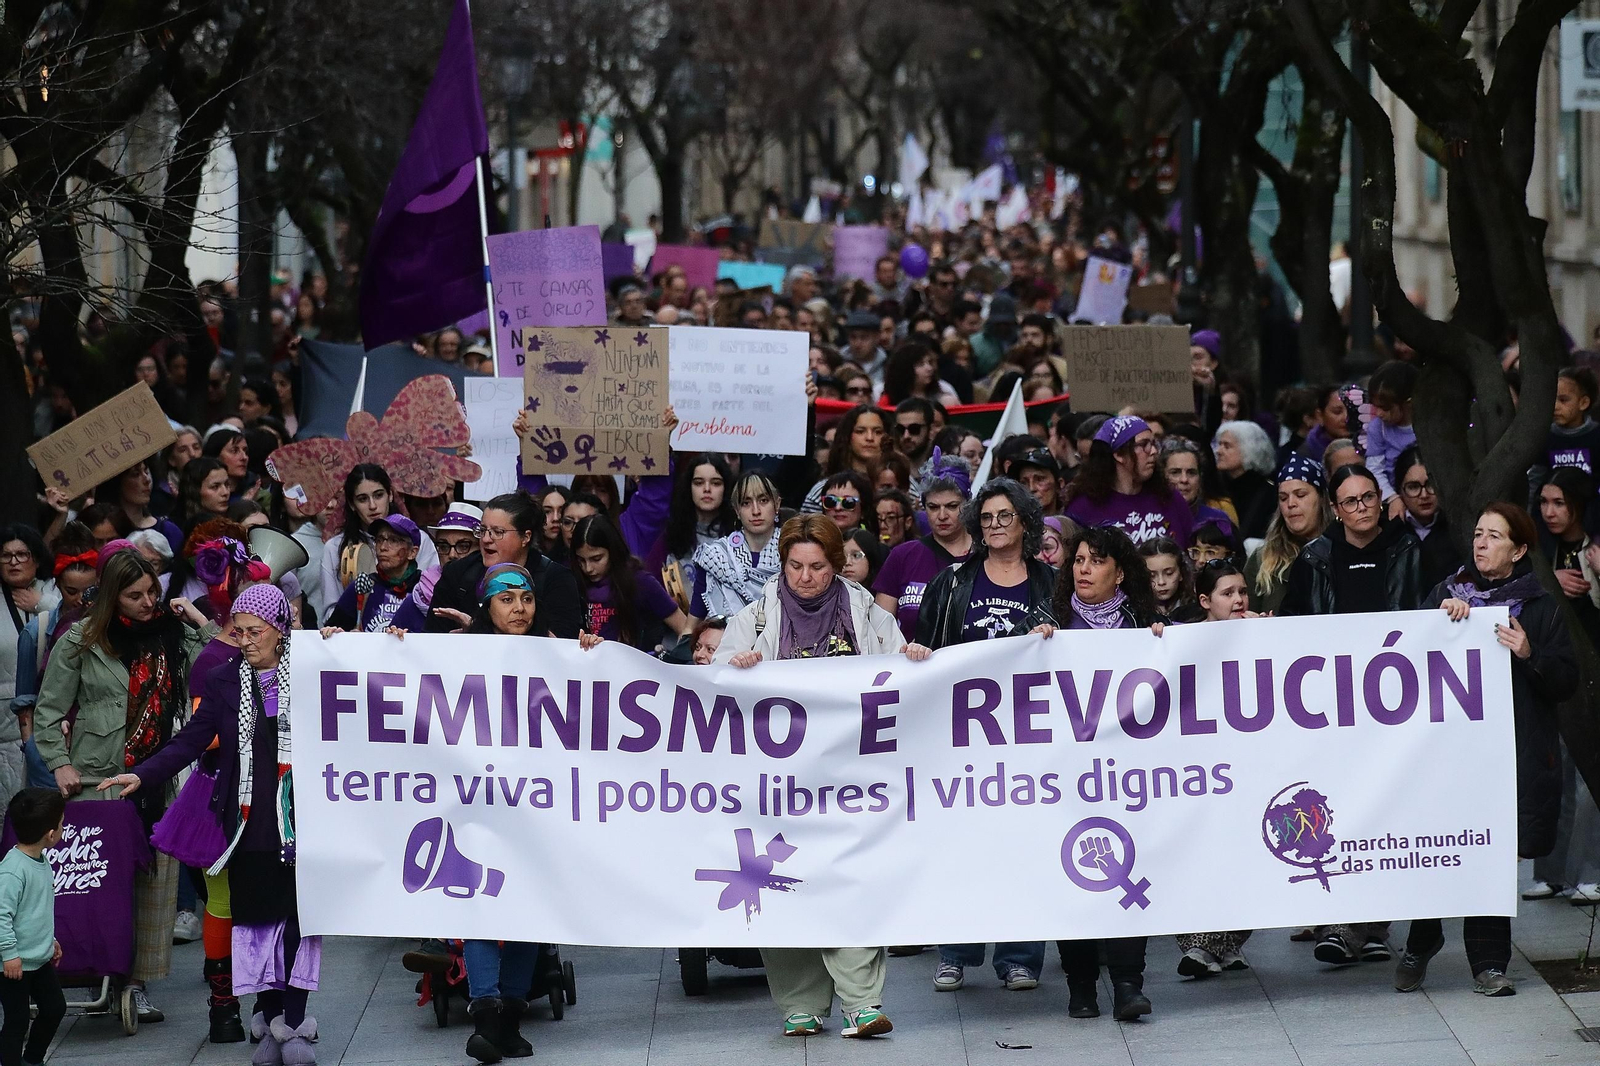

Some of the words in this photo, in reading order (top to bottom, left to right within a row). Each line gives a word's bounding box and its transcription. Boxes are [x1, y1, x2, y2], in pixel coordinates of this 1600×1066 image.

[540, 279, 594, 298] CANSAS
[516, 305, 532, 320] DE
[678, 417, 757, 441] problema
[1554, 453, 1575, 463] NON
[970, 599, 984, 609] LA
[321, 670, 807, 759] FEMINISMO
[859, 671, 900, 756] É
[952, 631, 1484, 748] REVOLUCIÓN
[322, 763, 437, 804] terra
[453, 764, 555, 809] viva
[598, 768, 742, 823] pobos
[759, 773, 890, 817] libres
[931, 762, 1062, 808] vidas
[1077, 758, 1233, 812] dignas
[80, 827, 103, 842] que
[1340, 833, 1410, 852] marcha
[1414, 828, 1491, 848] mundial
[1341, 855, 1374, 872] das
[1379, 851, 1462, 870] mulleres
